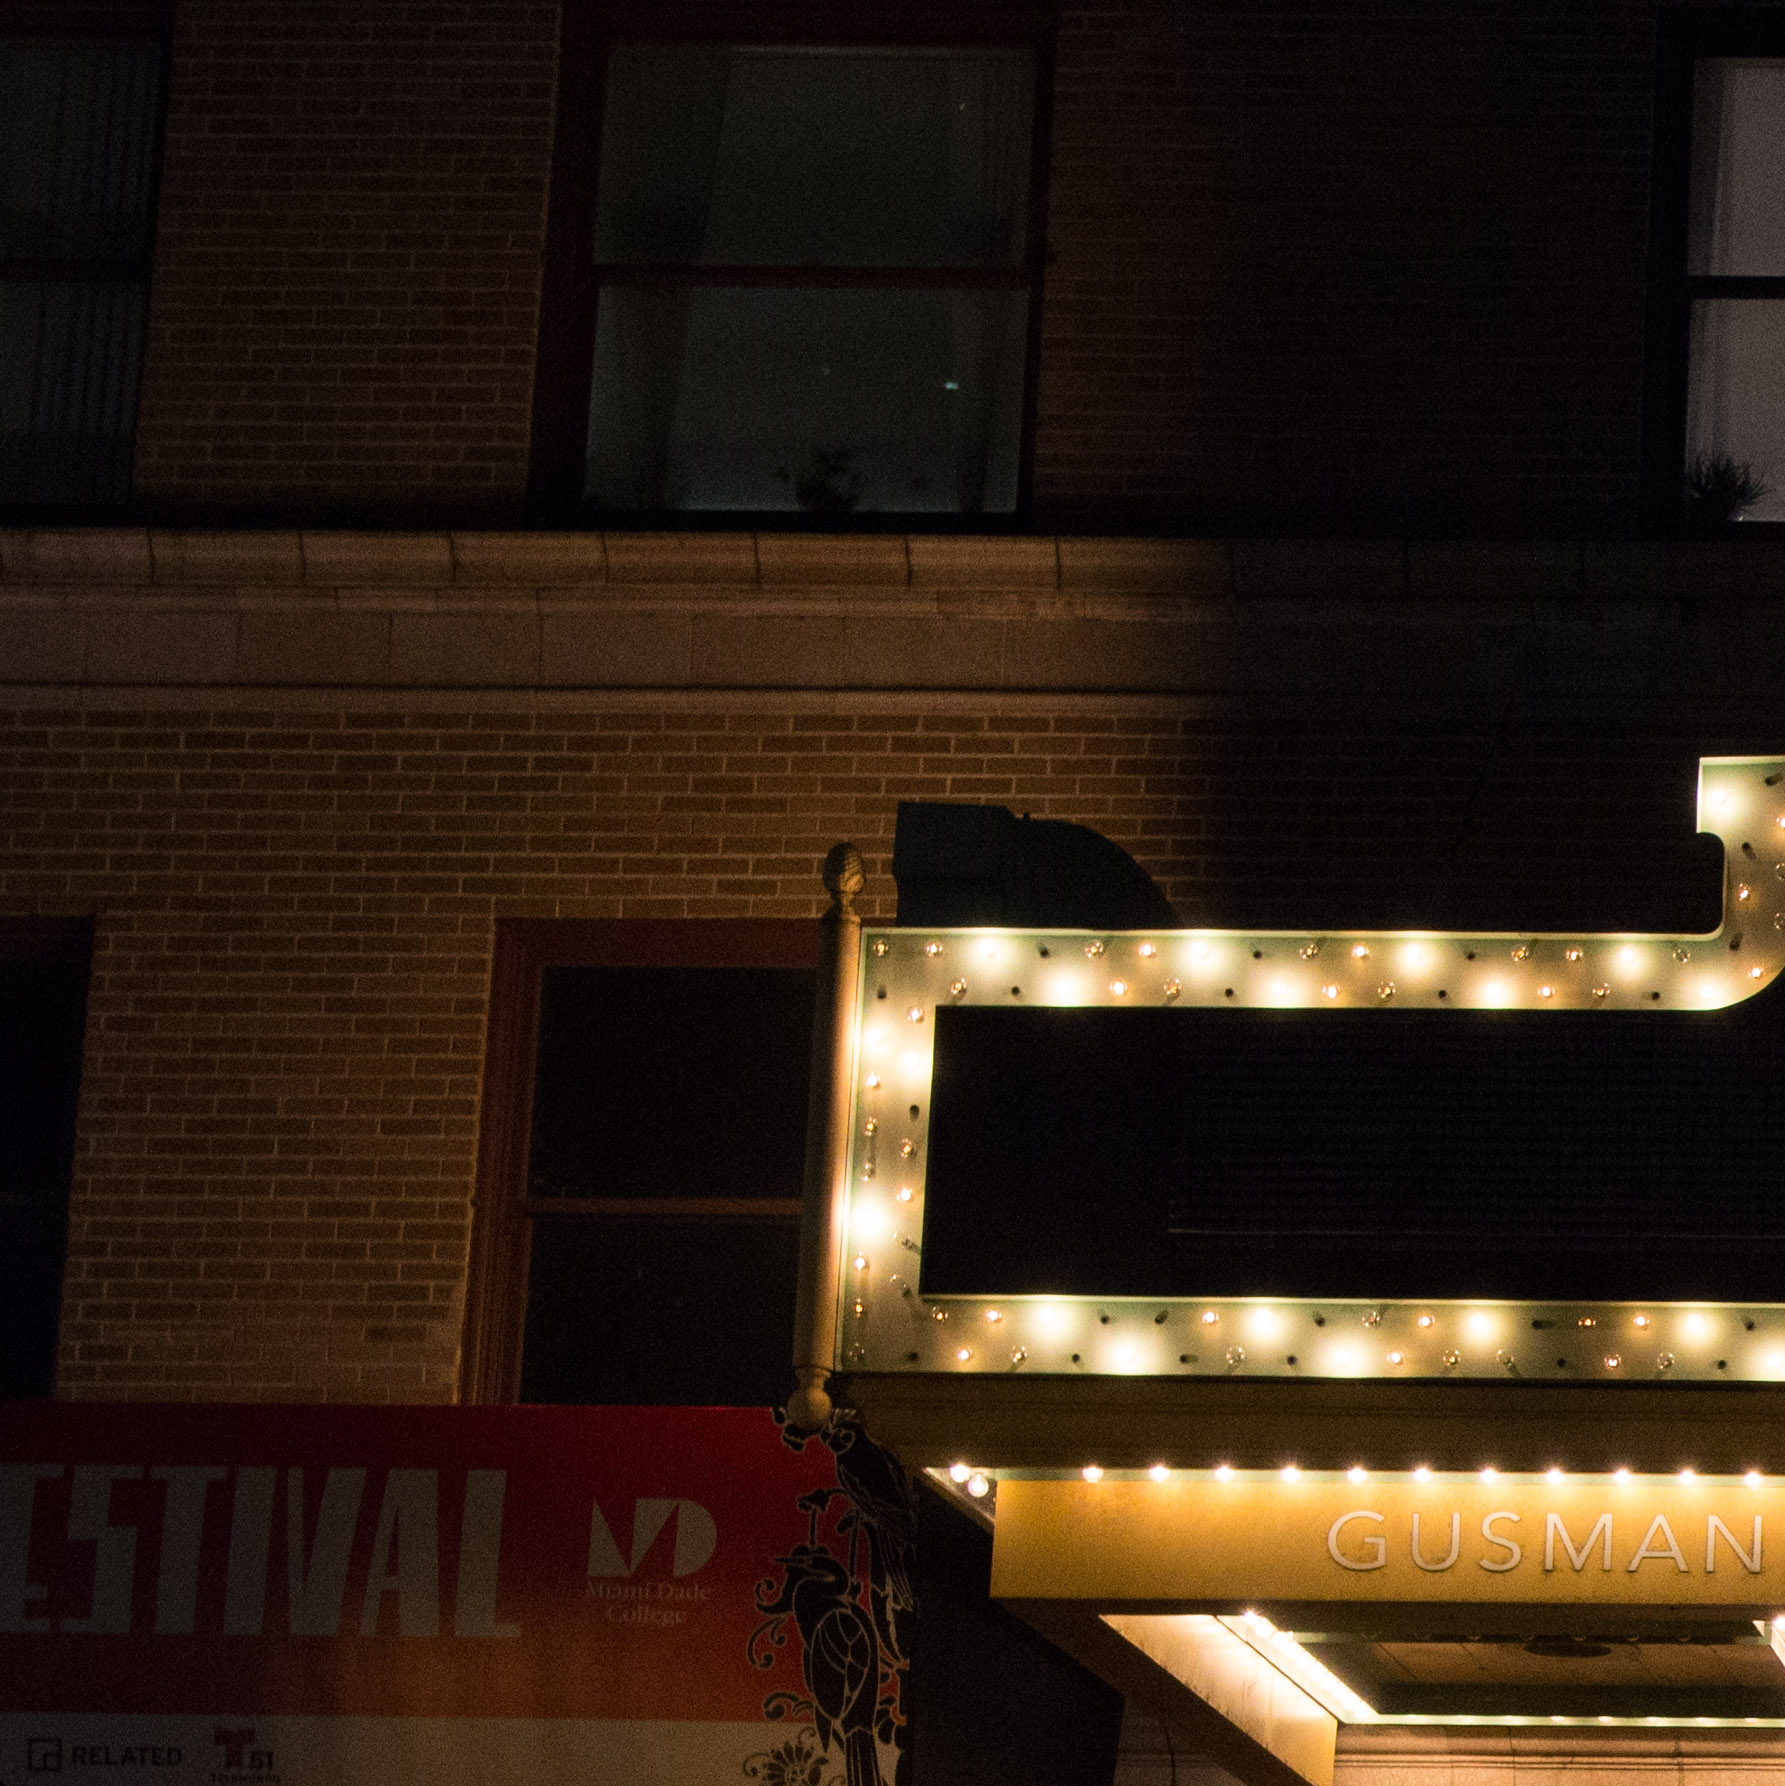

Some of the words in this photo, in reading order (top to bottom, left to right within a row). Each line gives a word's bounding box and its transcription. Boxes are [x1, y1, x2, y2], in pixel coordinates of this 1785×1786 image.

[1327, 1509, 1765, 1575] GUSMAN
[586, 1581, 652, 1602] Miami
[657, 1581, 713, 1602] Dade
[606, 1605, 688, 1627] College
[71, 1746, 183, 1766] RELATED
